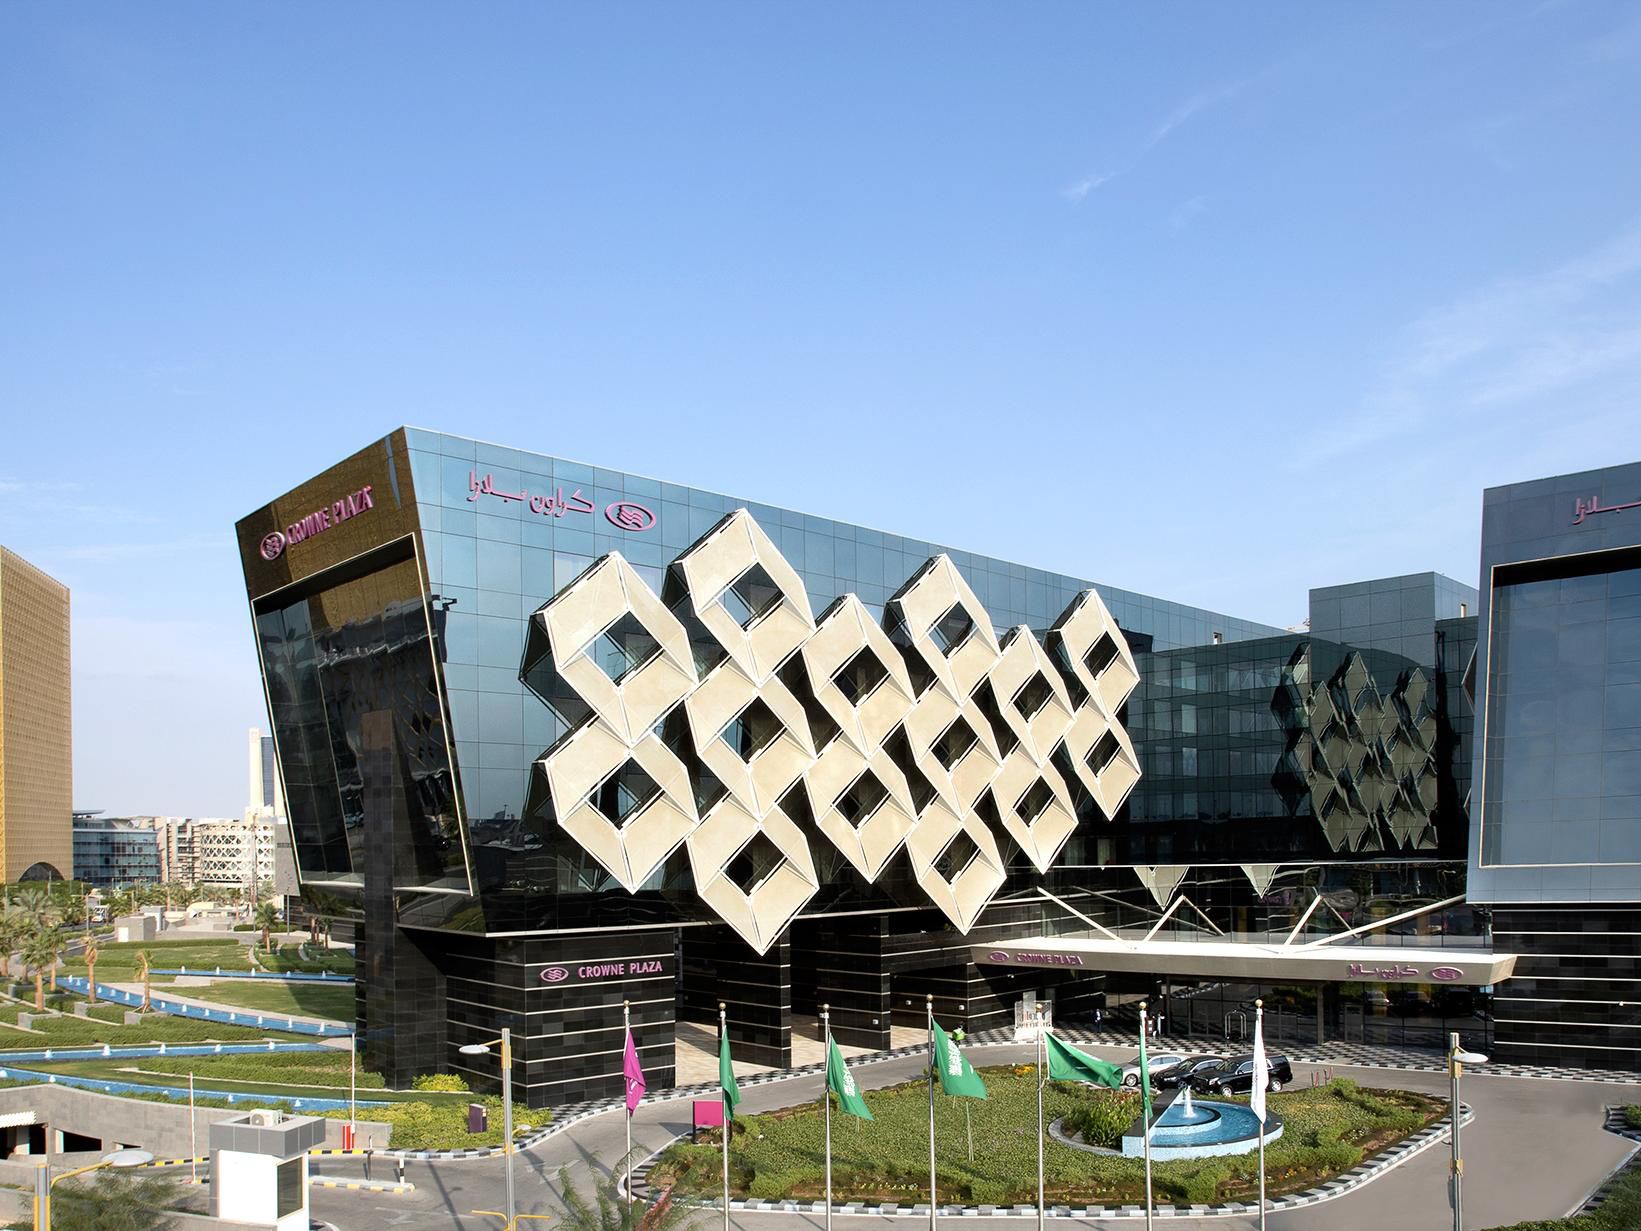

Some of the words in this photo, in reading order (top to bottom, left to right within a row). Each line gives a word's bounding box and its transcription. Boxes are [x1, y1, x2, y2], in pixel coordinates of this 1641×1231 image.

[466, 470, 528, 502] بلازا
[286, 507, 332, 545] CROWNE
[332, 485, 374, 524] PLAZA
[529, 487, 596, 517] كراون
[578, 963, 625, 978] CROWNE
[629, 961, 663, 974] PLAZA
[1016, 952, 1053, 964] CROWNE
[1054, 953, 1084, 966] PLAZA
